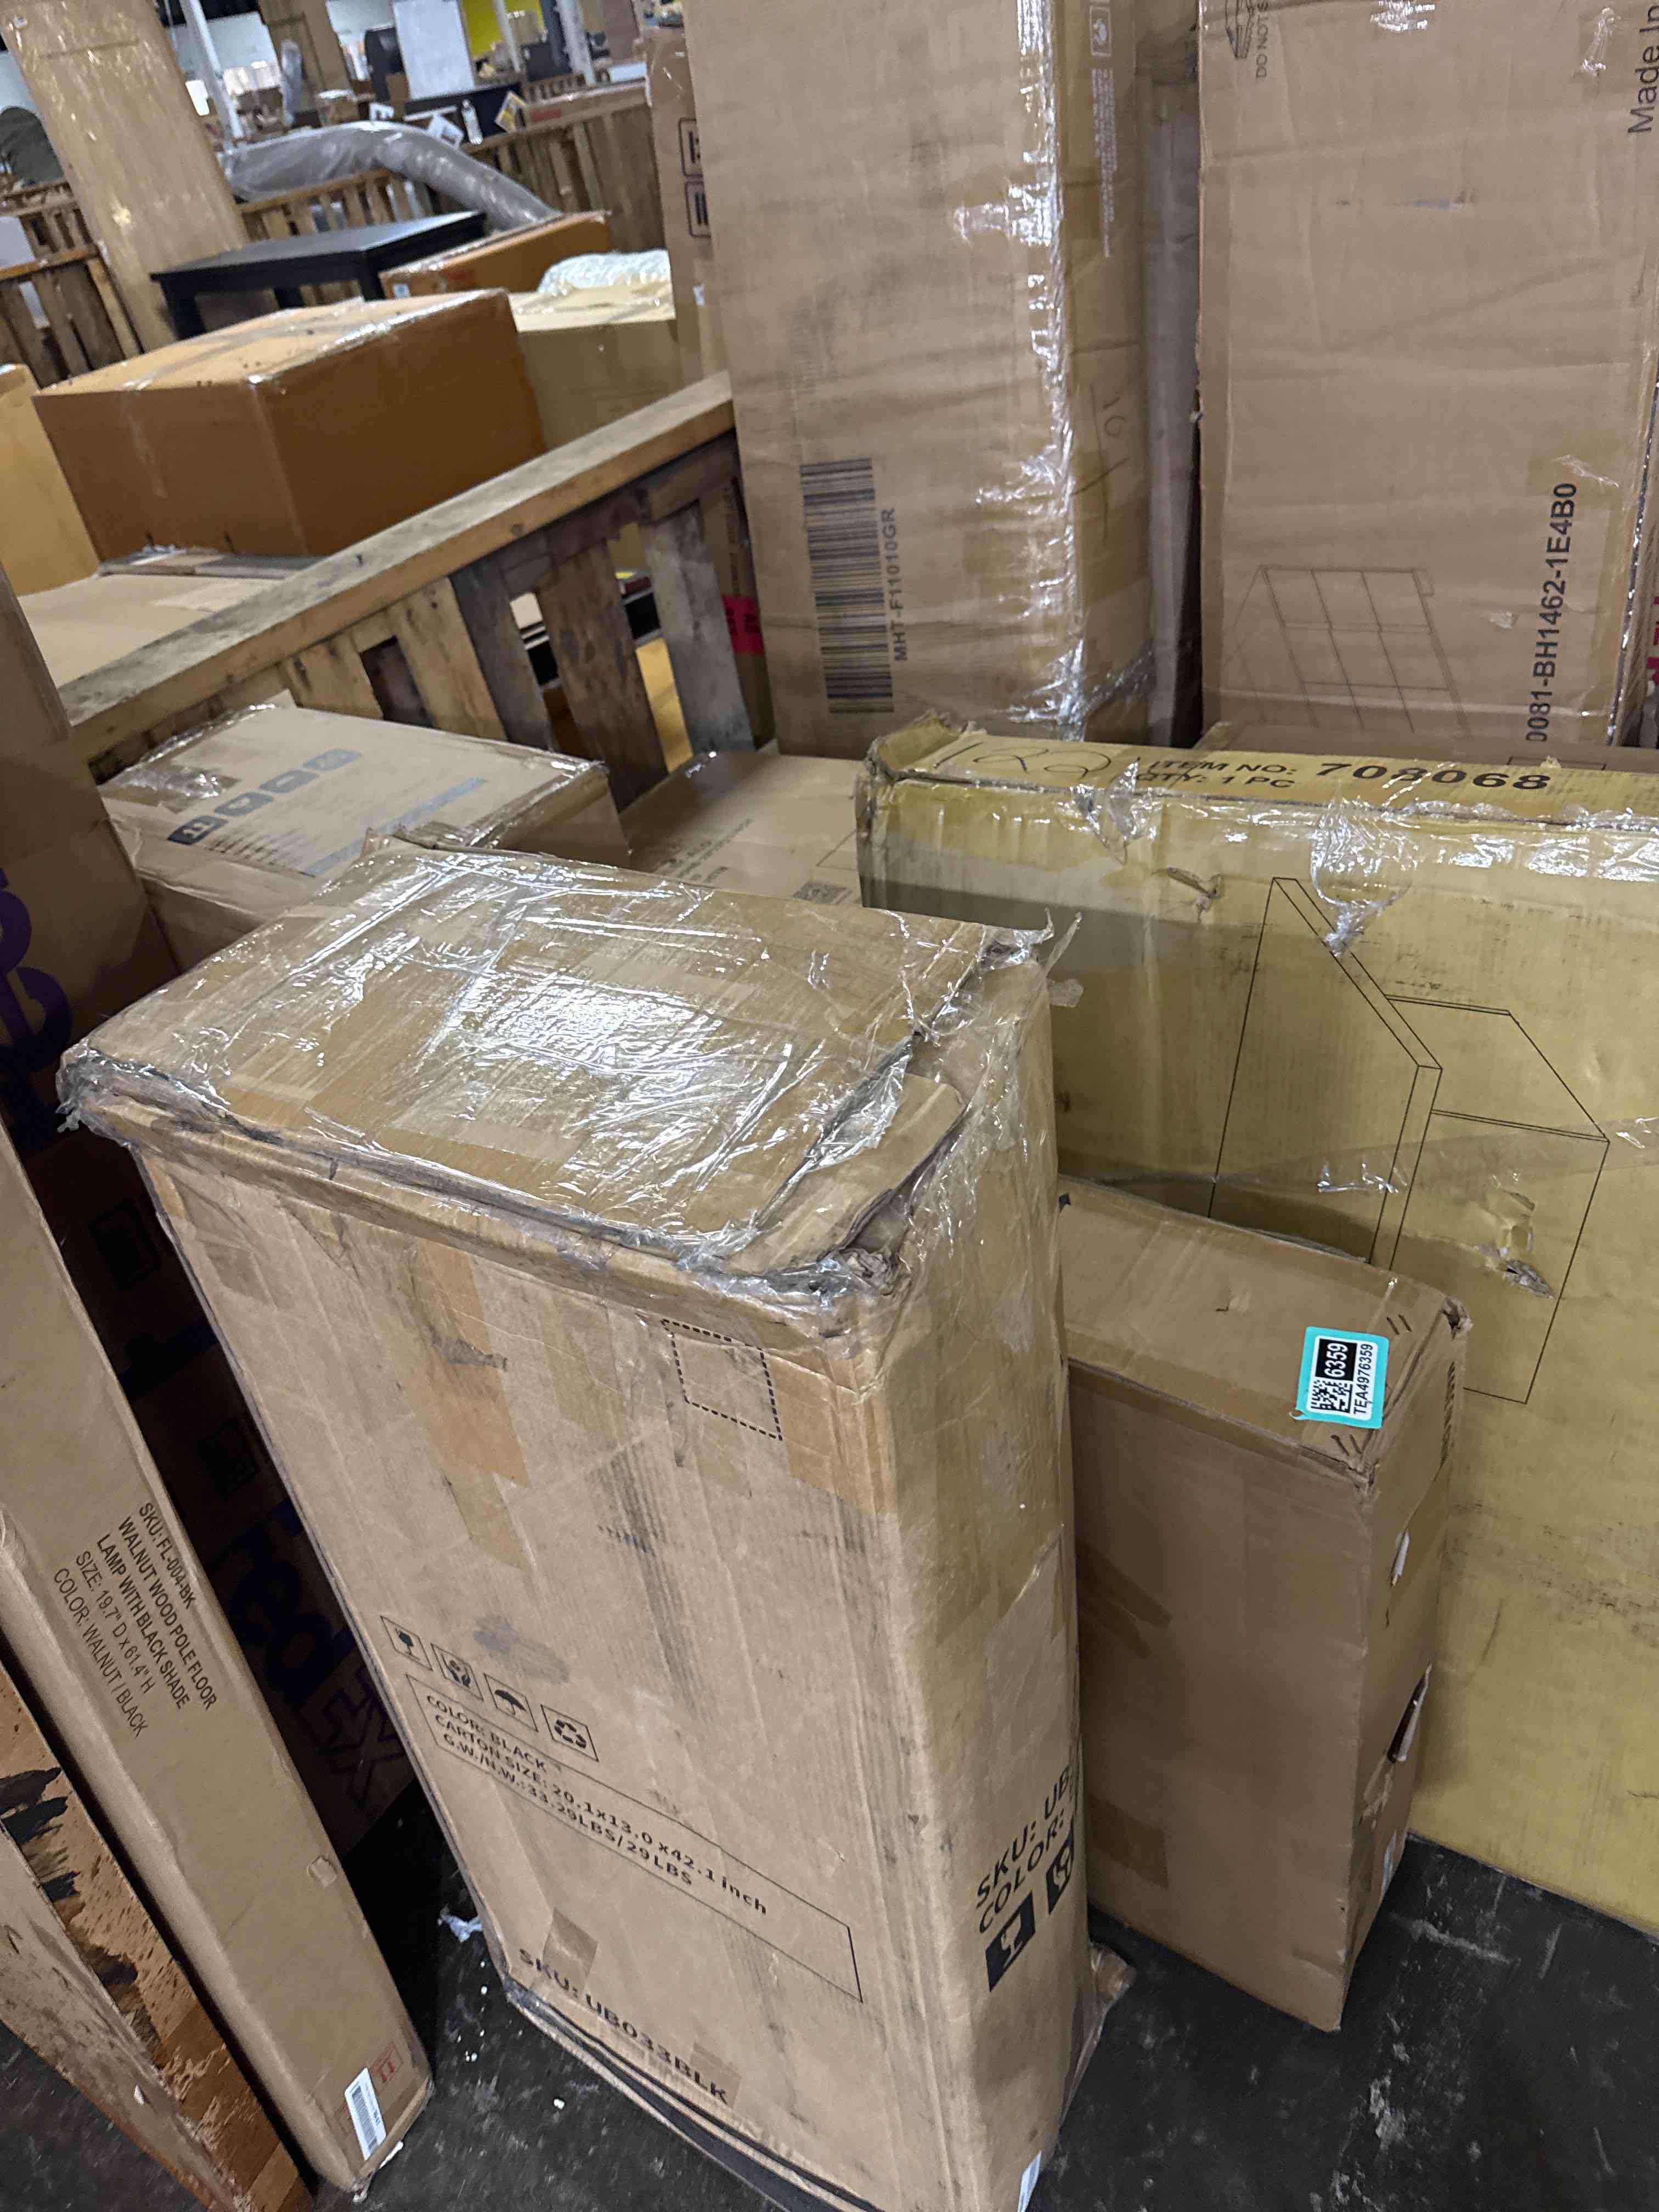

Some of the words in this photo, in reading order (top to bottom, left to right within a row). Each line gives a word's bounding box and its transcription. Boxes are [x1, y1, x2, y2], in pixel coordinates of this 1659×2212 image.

[1639, 4, 1659, 33] In
[1255, 54, 1268, 79] DO
[1628, 45, 1659, 133] Made
[1235, 764, 1297, 775] NO:
[1317, 763, 1551, 790] 708068
[1244, 776, 1295, 788] PC
[1324, 1342, 1348, 1378] 6359
[1353, 1344, 1373, 1414] TEA4976359
[76, 1550, 103, 1592] SIZE:
[139, 1502, 163, 1541] SKU:
[156, 1537, 196, 1610] FL-004-BK
[96, 1590, 122, 1621] 19.7"
[97, 1533, 127, 1575] LAMP
[119, 1575, 146, 1617] WITH
[136, 1611, 168, 1664] BLACK
[159, 1660, 191, 1710] SHADE
[112, 1622, 127, 1638] D
[119, 1515, 157, 1581] WALNUT
[149, 1578, 178, 1627] WOOD
[170, 1623, 196, 1665] POLE
[187, 1660, 218, 1711] FLOOR
[54, 1567, 90, 1627] COLOR:
[82, 1622, 122, 1685] WALNUT
[115, 1688, 149, 1739] BLACK
[118, 1637, 131, 1650] x
[123, 1645, 150, 1677] 61.4"
[140, 1676, 157, 1695] H
[426, 1695, 485, 1735] COLOR:
[490, 1731, 547, 1773] BLACK
[435, 1714, 500, 1759] CARTON
[505, 1756, 548, 1788] SIZE:
[721, 1876, 766, 1915] inch
[975, 1820, 1036, 1909] SKU:
[979, 1808, 1065, 1934] COLOR:
[519, 1948, 579, 1999] SKU:
[585, 1993, 728, 2106] UB033BLK
